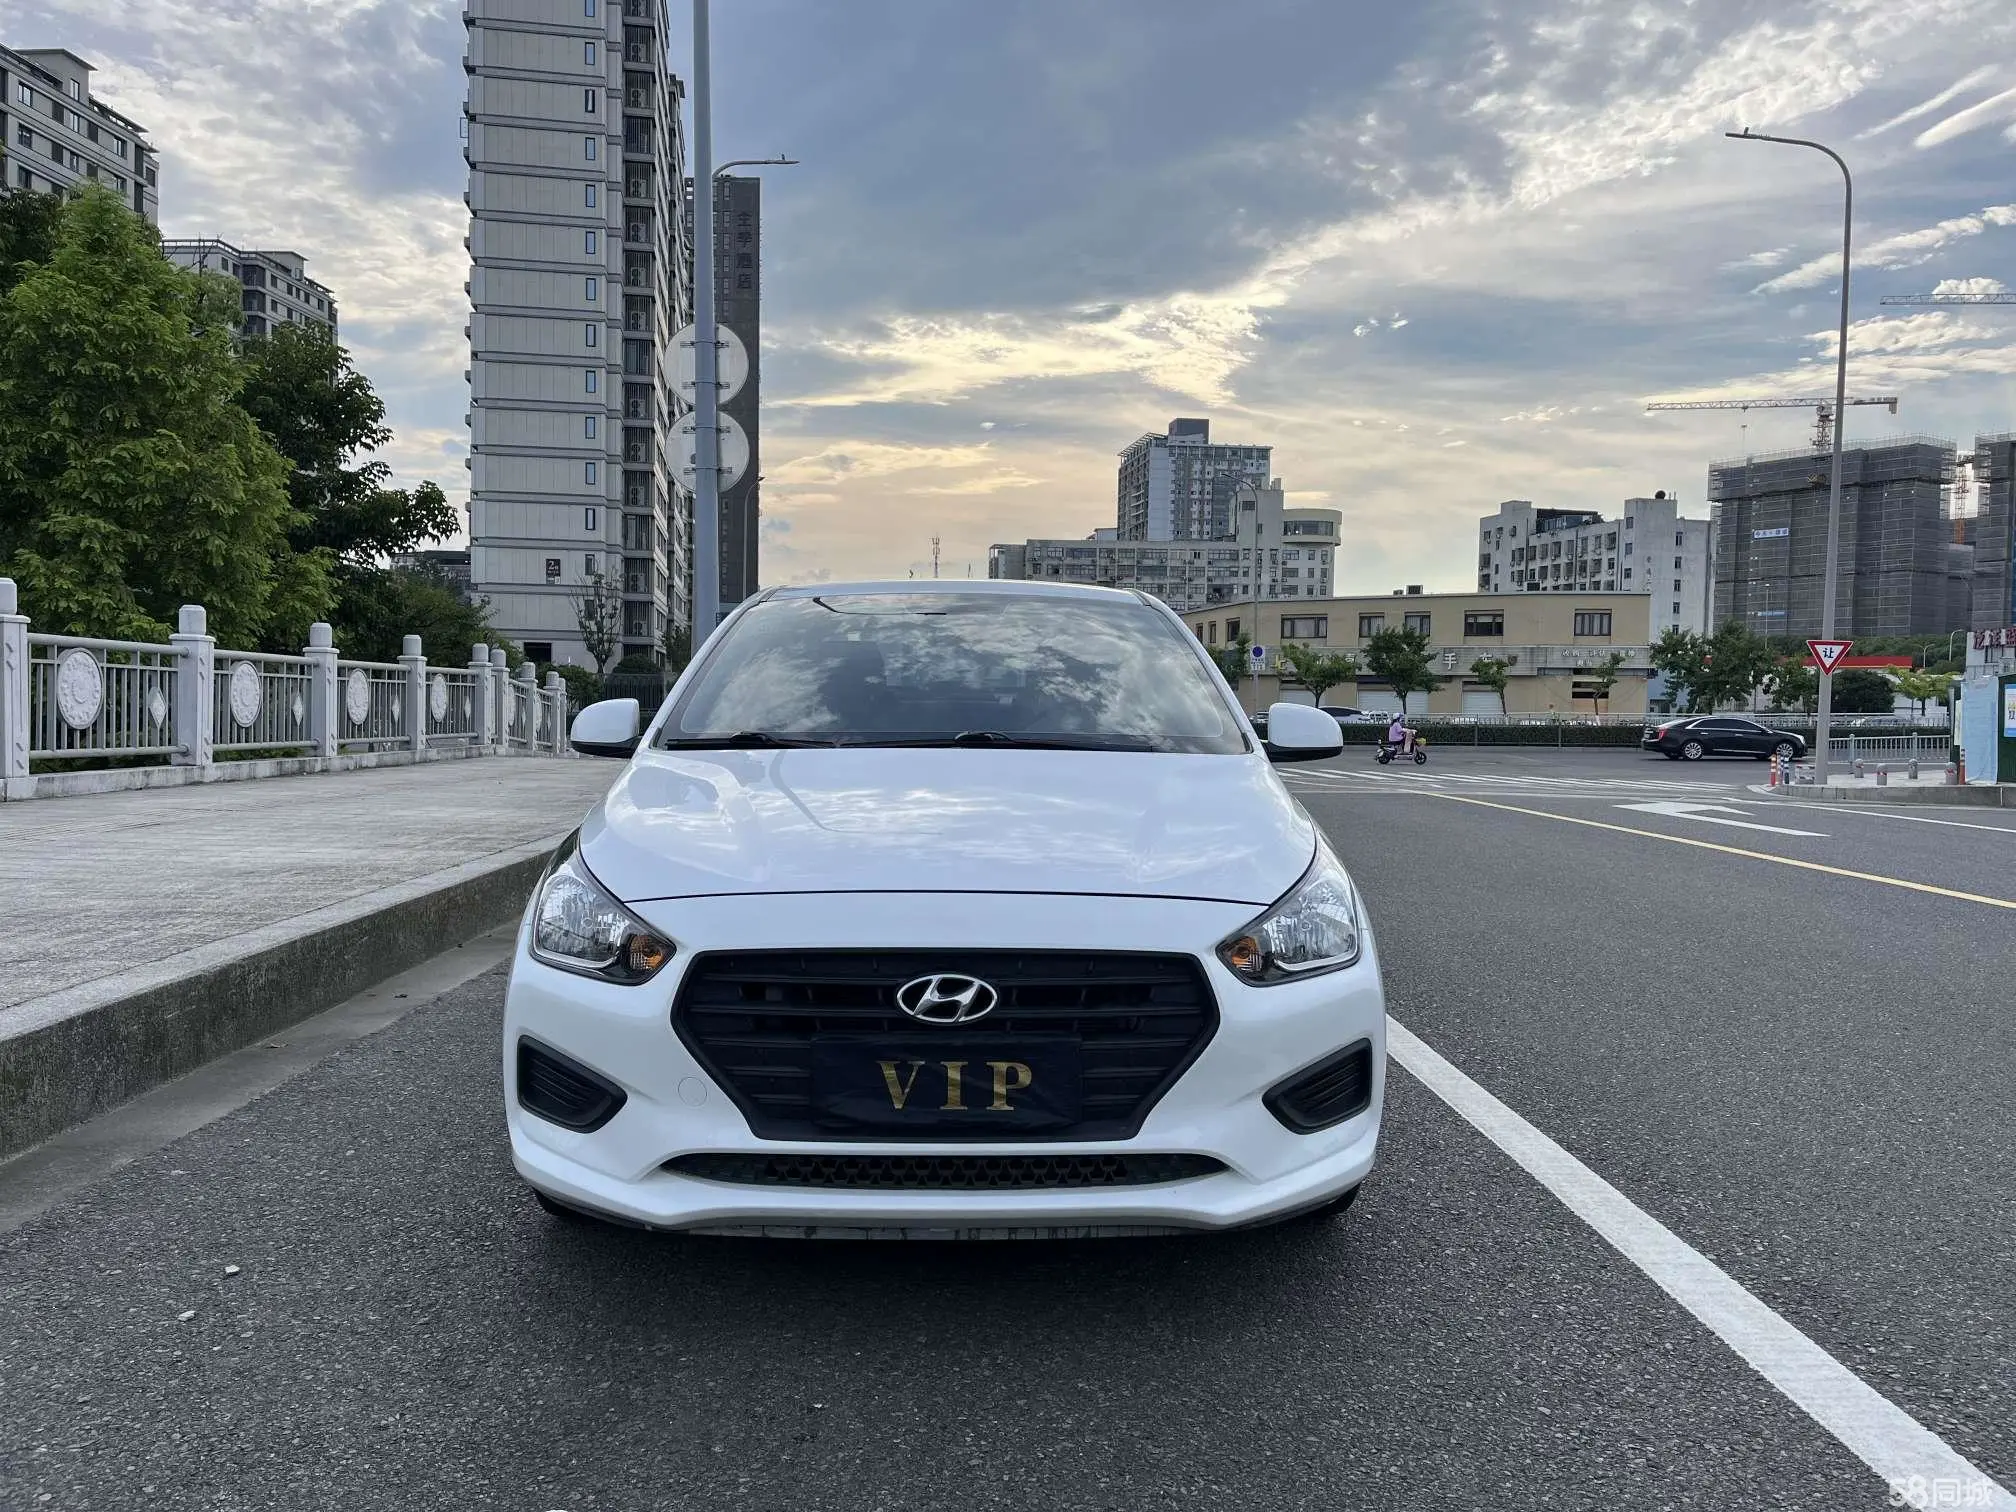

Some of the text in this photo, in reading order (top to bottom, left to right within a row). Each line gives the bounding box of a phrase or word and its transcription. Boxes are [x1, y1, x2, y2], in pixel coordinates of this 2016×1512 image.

[736, 211, 752, 289] 全季酒店
[1823, 647, 1835, 658] 让
[876, 1061, 1032, 1110] VIP
